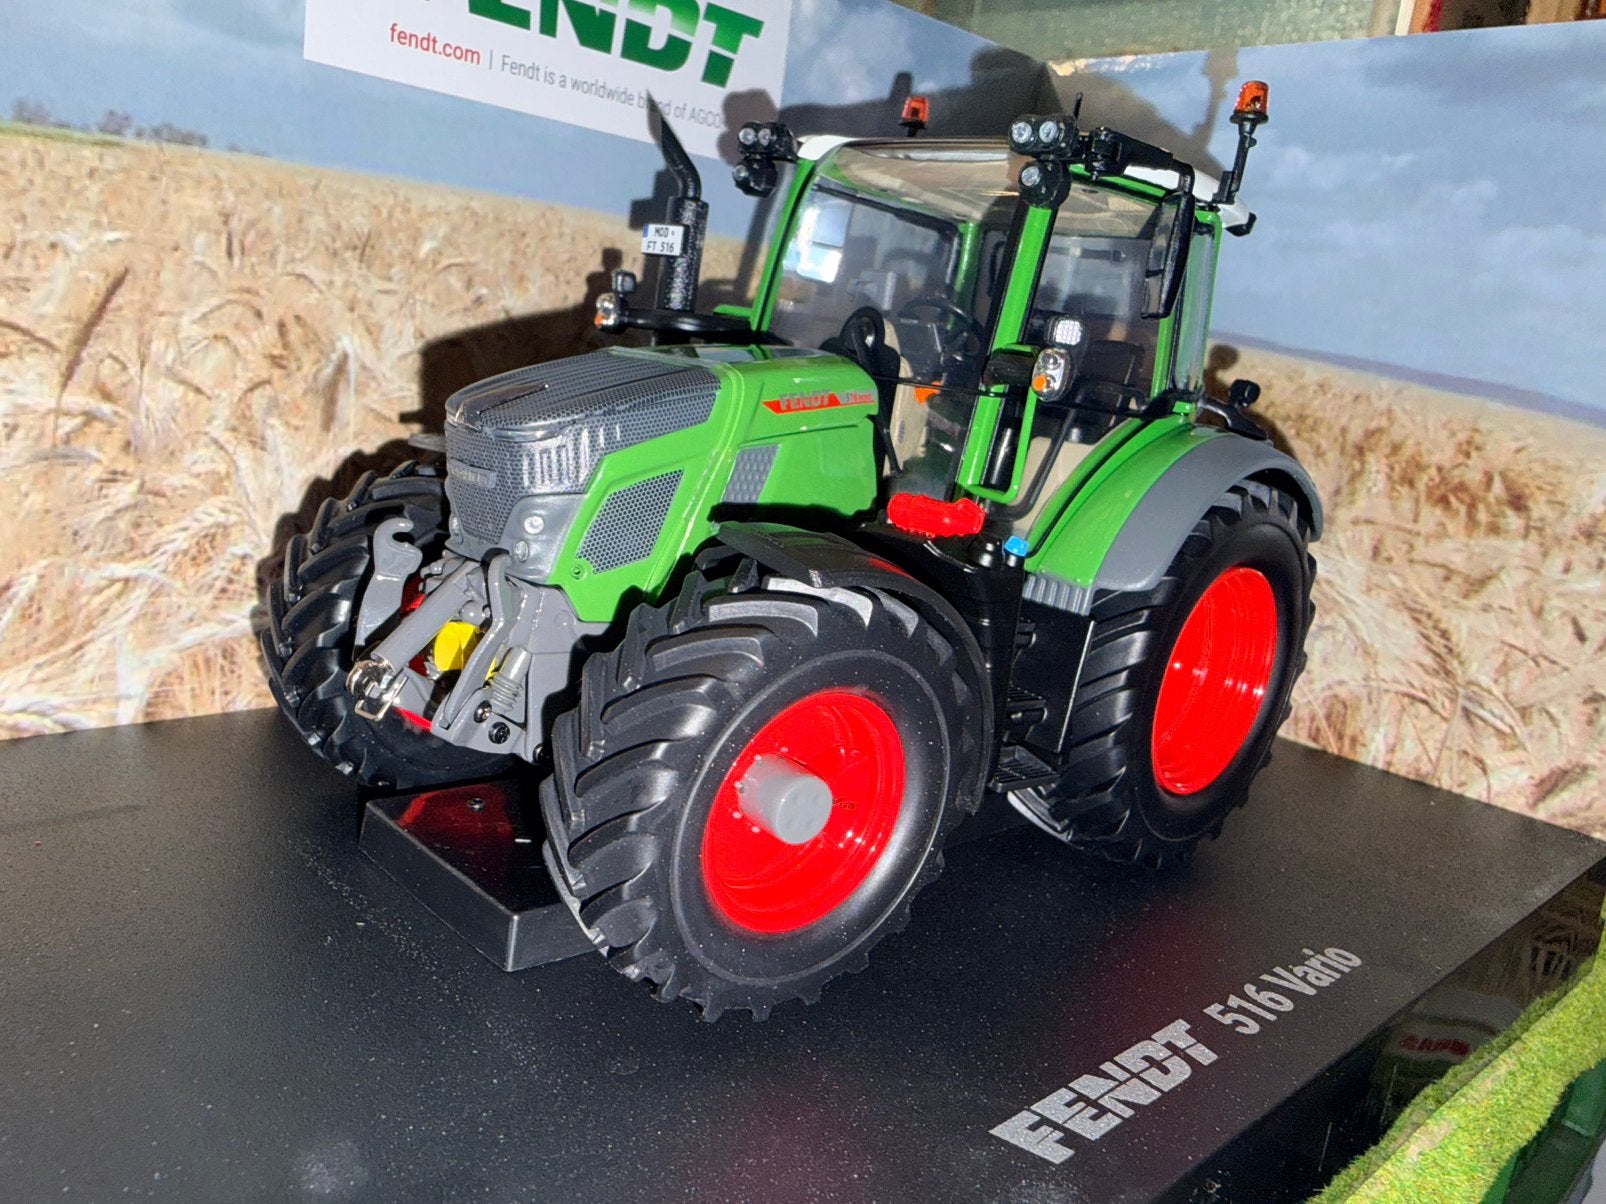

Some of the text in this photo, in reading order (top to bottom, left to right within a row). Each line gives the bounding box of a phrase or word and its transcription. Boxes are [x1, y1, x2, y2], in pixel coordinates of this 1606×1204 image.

[389, 22, 481, 65] fendt.com
[501, 54, 541, 82] Fendt
[543, 65, 556, 86] is
[559, 73, 567, 89] a
[570, 76, 635, 107] worldwide
[673, 102, 688, 120] of
[646, 240, 675, 253] FT 516
[779, 388, 833, 411] FENDT
[987, 947, 1362, 1165] FENDT 516 Vario
